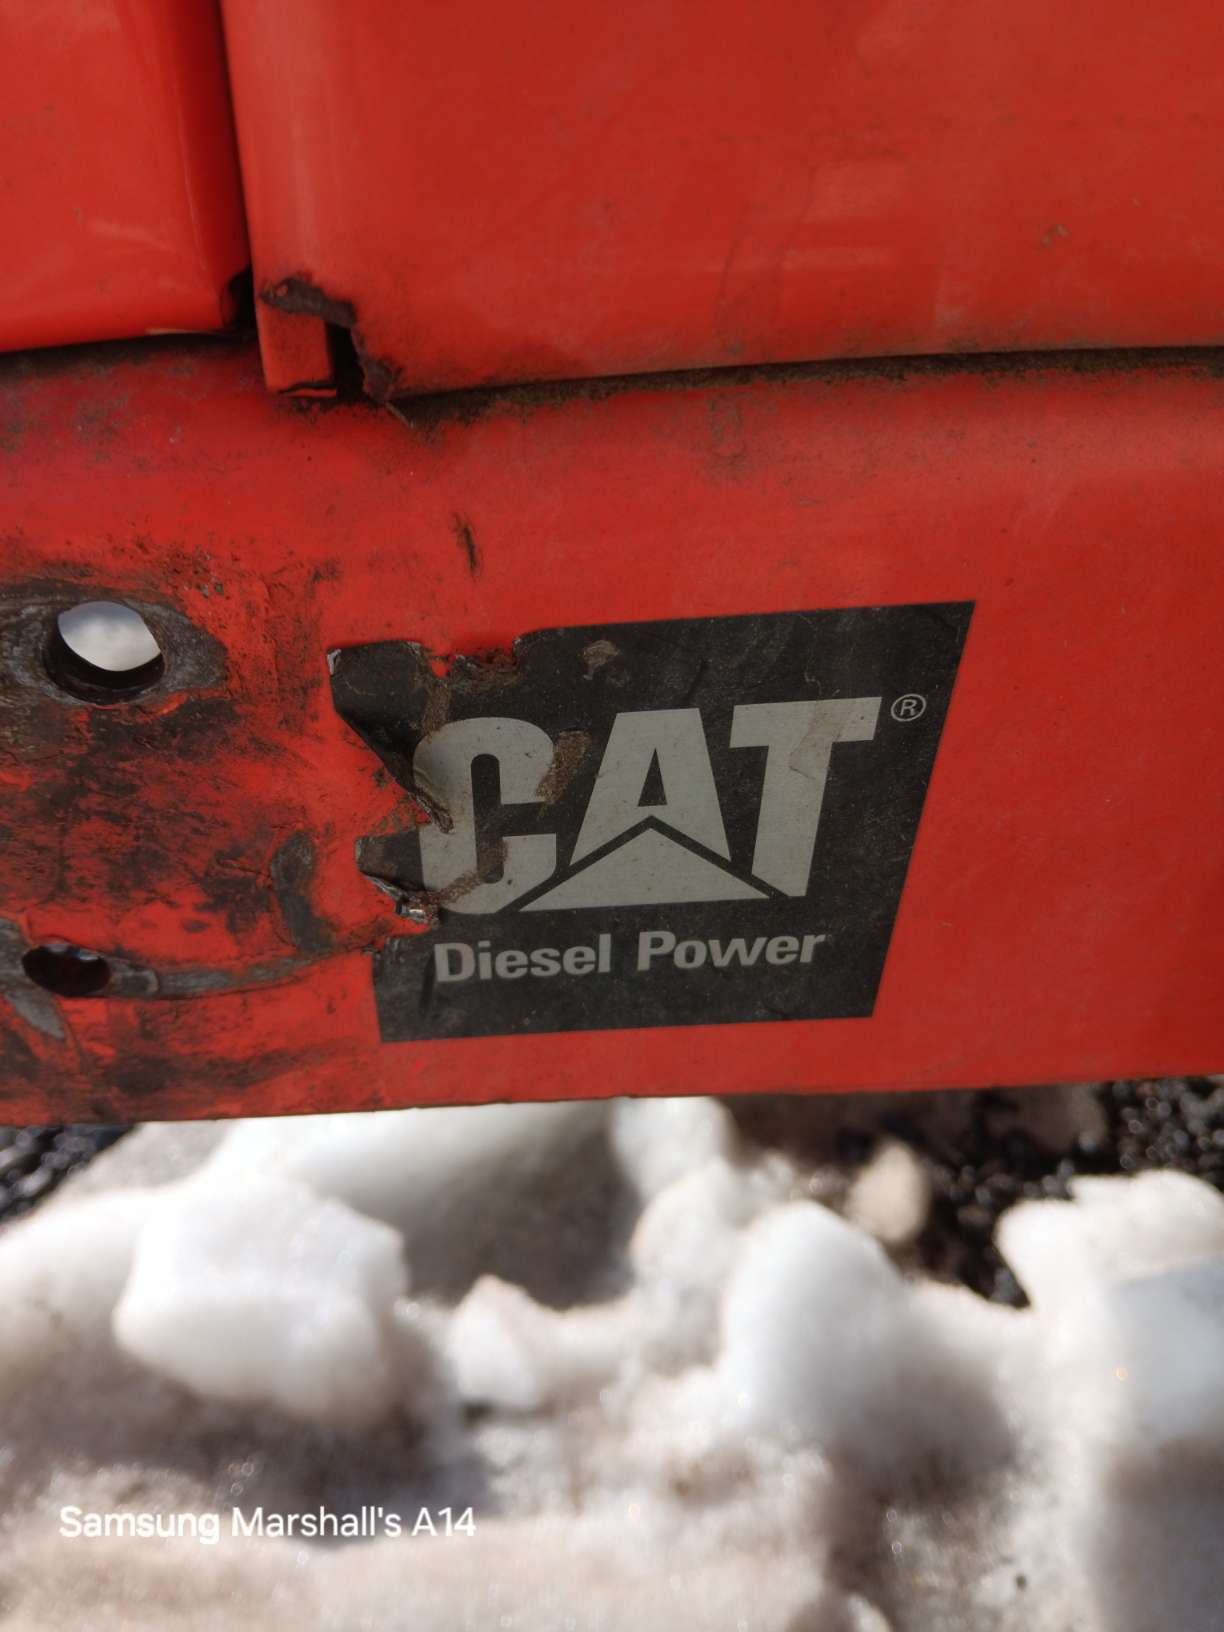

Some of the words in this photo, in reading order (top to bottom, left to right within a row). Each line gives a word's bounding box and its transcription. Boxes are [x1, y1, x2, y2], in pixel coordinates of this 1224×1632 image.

[413, 697, 883, 915] CAT
[433, 933, 611, 983] Diesel
[637, 931, 826, 971] Power
